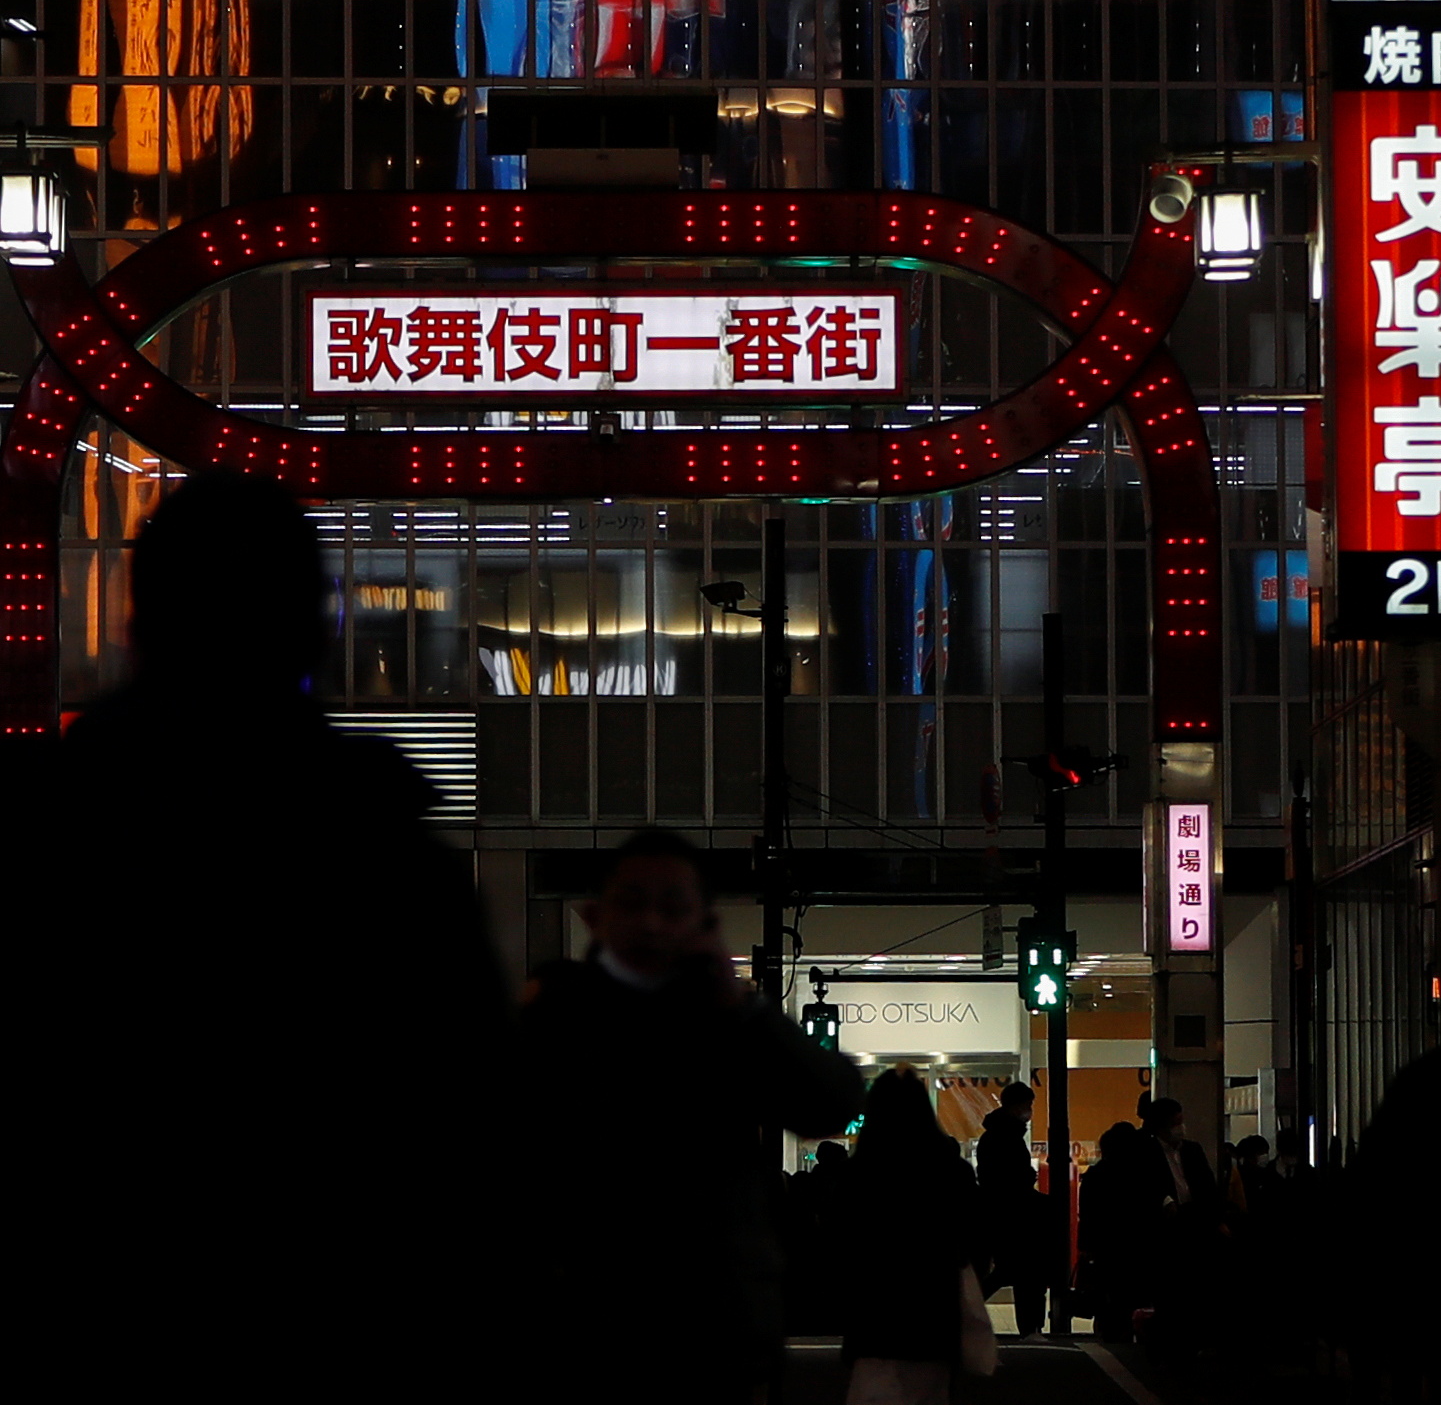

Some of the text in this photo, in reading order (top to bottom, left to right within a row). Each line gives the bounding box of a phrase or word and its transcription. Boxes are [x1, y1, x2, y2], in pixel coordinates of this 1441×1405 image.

[327, 306, 883, 385] 歌舞伎町一番街
[1175, 814, 1202, 940] 劇場通り
[882, 1002, 980, 1024] OTSUKA
